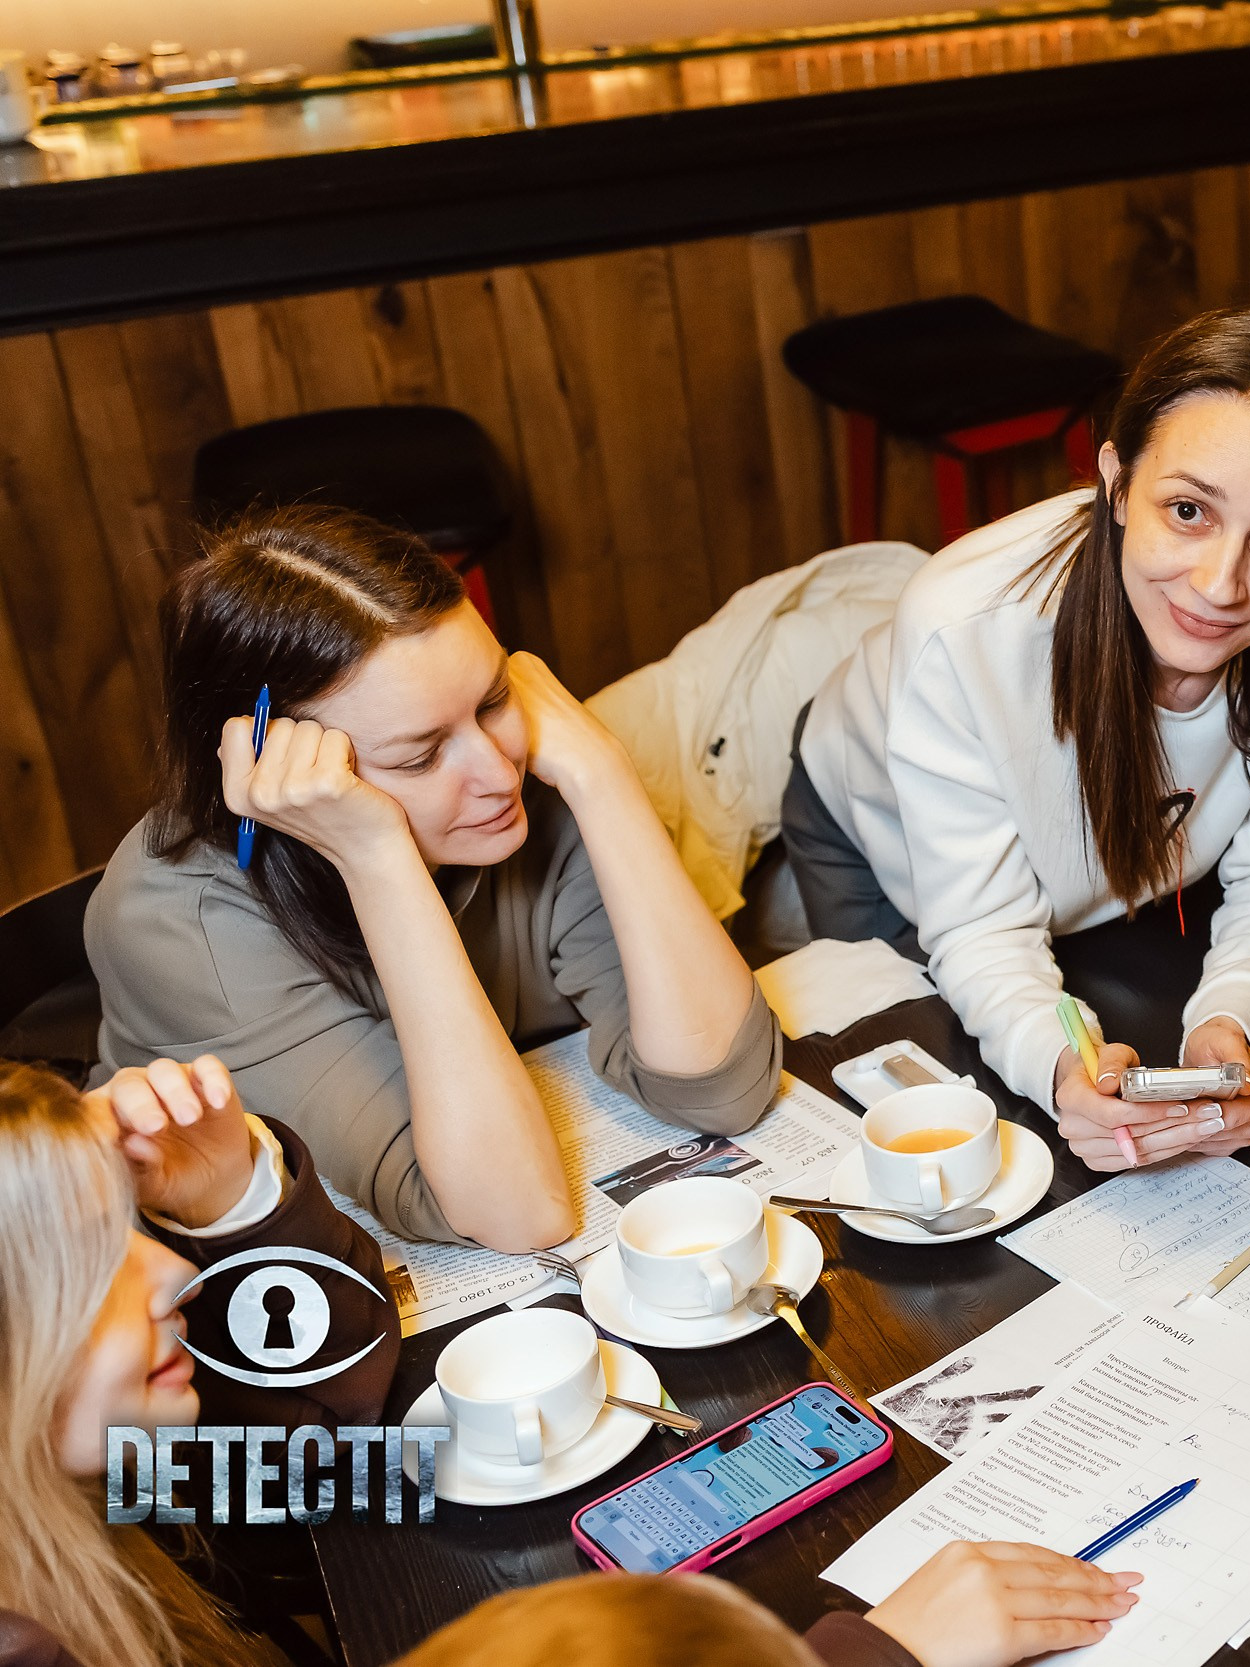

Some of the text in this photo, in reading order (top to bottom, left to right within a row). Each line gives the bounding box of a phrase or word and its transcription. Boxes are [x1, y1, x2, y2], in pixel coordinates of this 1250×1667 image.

[458, 1272, 534, 1303] 13.02.1980
[1142, 1314, 1194, 1345] ПРОФАЙЛ
[1091, 1365, 1152, 1398] разными людьми?
[1099, 1359, 1114, 1370] ним
[1114, 1367, 1148, 1387] человеком
[1151, 1386, 1180, 1403] группой
[1106, 1352, 1152, 1380] Преступления
[1150, 1377, 1189, 1397] совершены
[1186, 1394, 1199, 1402] од-
[1161, 1356, 1190, 1373] Вопрос
[1056, 1395, 1142, 1441] По какой причине Эбигейл
[1069, 1384, 1153, 1426] ний были спланированы?
[1077, 1377, 1169, 1426] Какое количество преступле-
[1029, 1417, 1052, 1432] Имеет
[1060, 1433, 1087, 1451] человек,
[1091, 1450, 1122, 1467] котором
[1041, 1409, 1103, 1440] альному насилию?
[1049, 1402, 1068, 1414] Смит
[1074, 1415, 1118, 1440] подвергалась
[1117, 1437, 1138, 1449] сексу-
[979, 1459, 998, 1471] №5?
[1007, 1437, 1072, 1472] ству Эбигейл Смит?
[1015, 1431, 1028, 1441] чая
[1026, 1436, 1041, 1448] №2,
[1039, 1444, 1078, 1465] отношение
[1079, 1465, 1101, 1477] убий-
[1020, 1424, 1055, 1444] упоминал
[1053, 1441, 1087, 1461] свидетель
[1095, 1462, 1111, 1472] слу-
[986, 1454, 1015, 1470] ленный
[1010, 1467, 1042, 1485] убийцей
[1045, 1484, 1069, 1498] случае
[996, 1446, 1084, 1495] Что означает символ, остав-
[941, 1491, 987, 1517] другие дни?)
[950, 1484, 991, 1507] преступник
[988, 1504, 1010, 1517] начал
[1008, 1514, 1039, 1532] нападать
[958, 1477, 1043, 1523] дней нападений? (Почему
[973, 1473, 986, 1484] чем
[984, 1481, 1012, 1497] связано
[1010, 1493, 1048, 1515] изменение
[909, 1517, 934, 1532] шкаф?
[917, 1510, 970, 1542] поместил тело
[925, 1503, 952, 1521] Почему
[955, 1521, 979, 1536] случае
